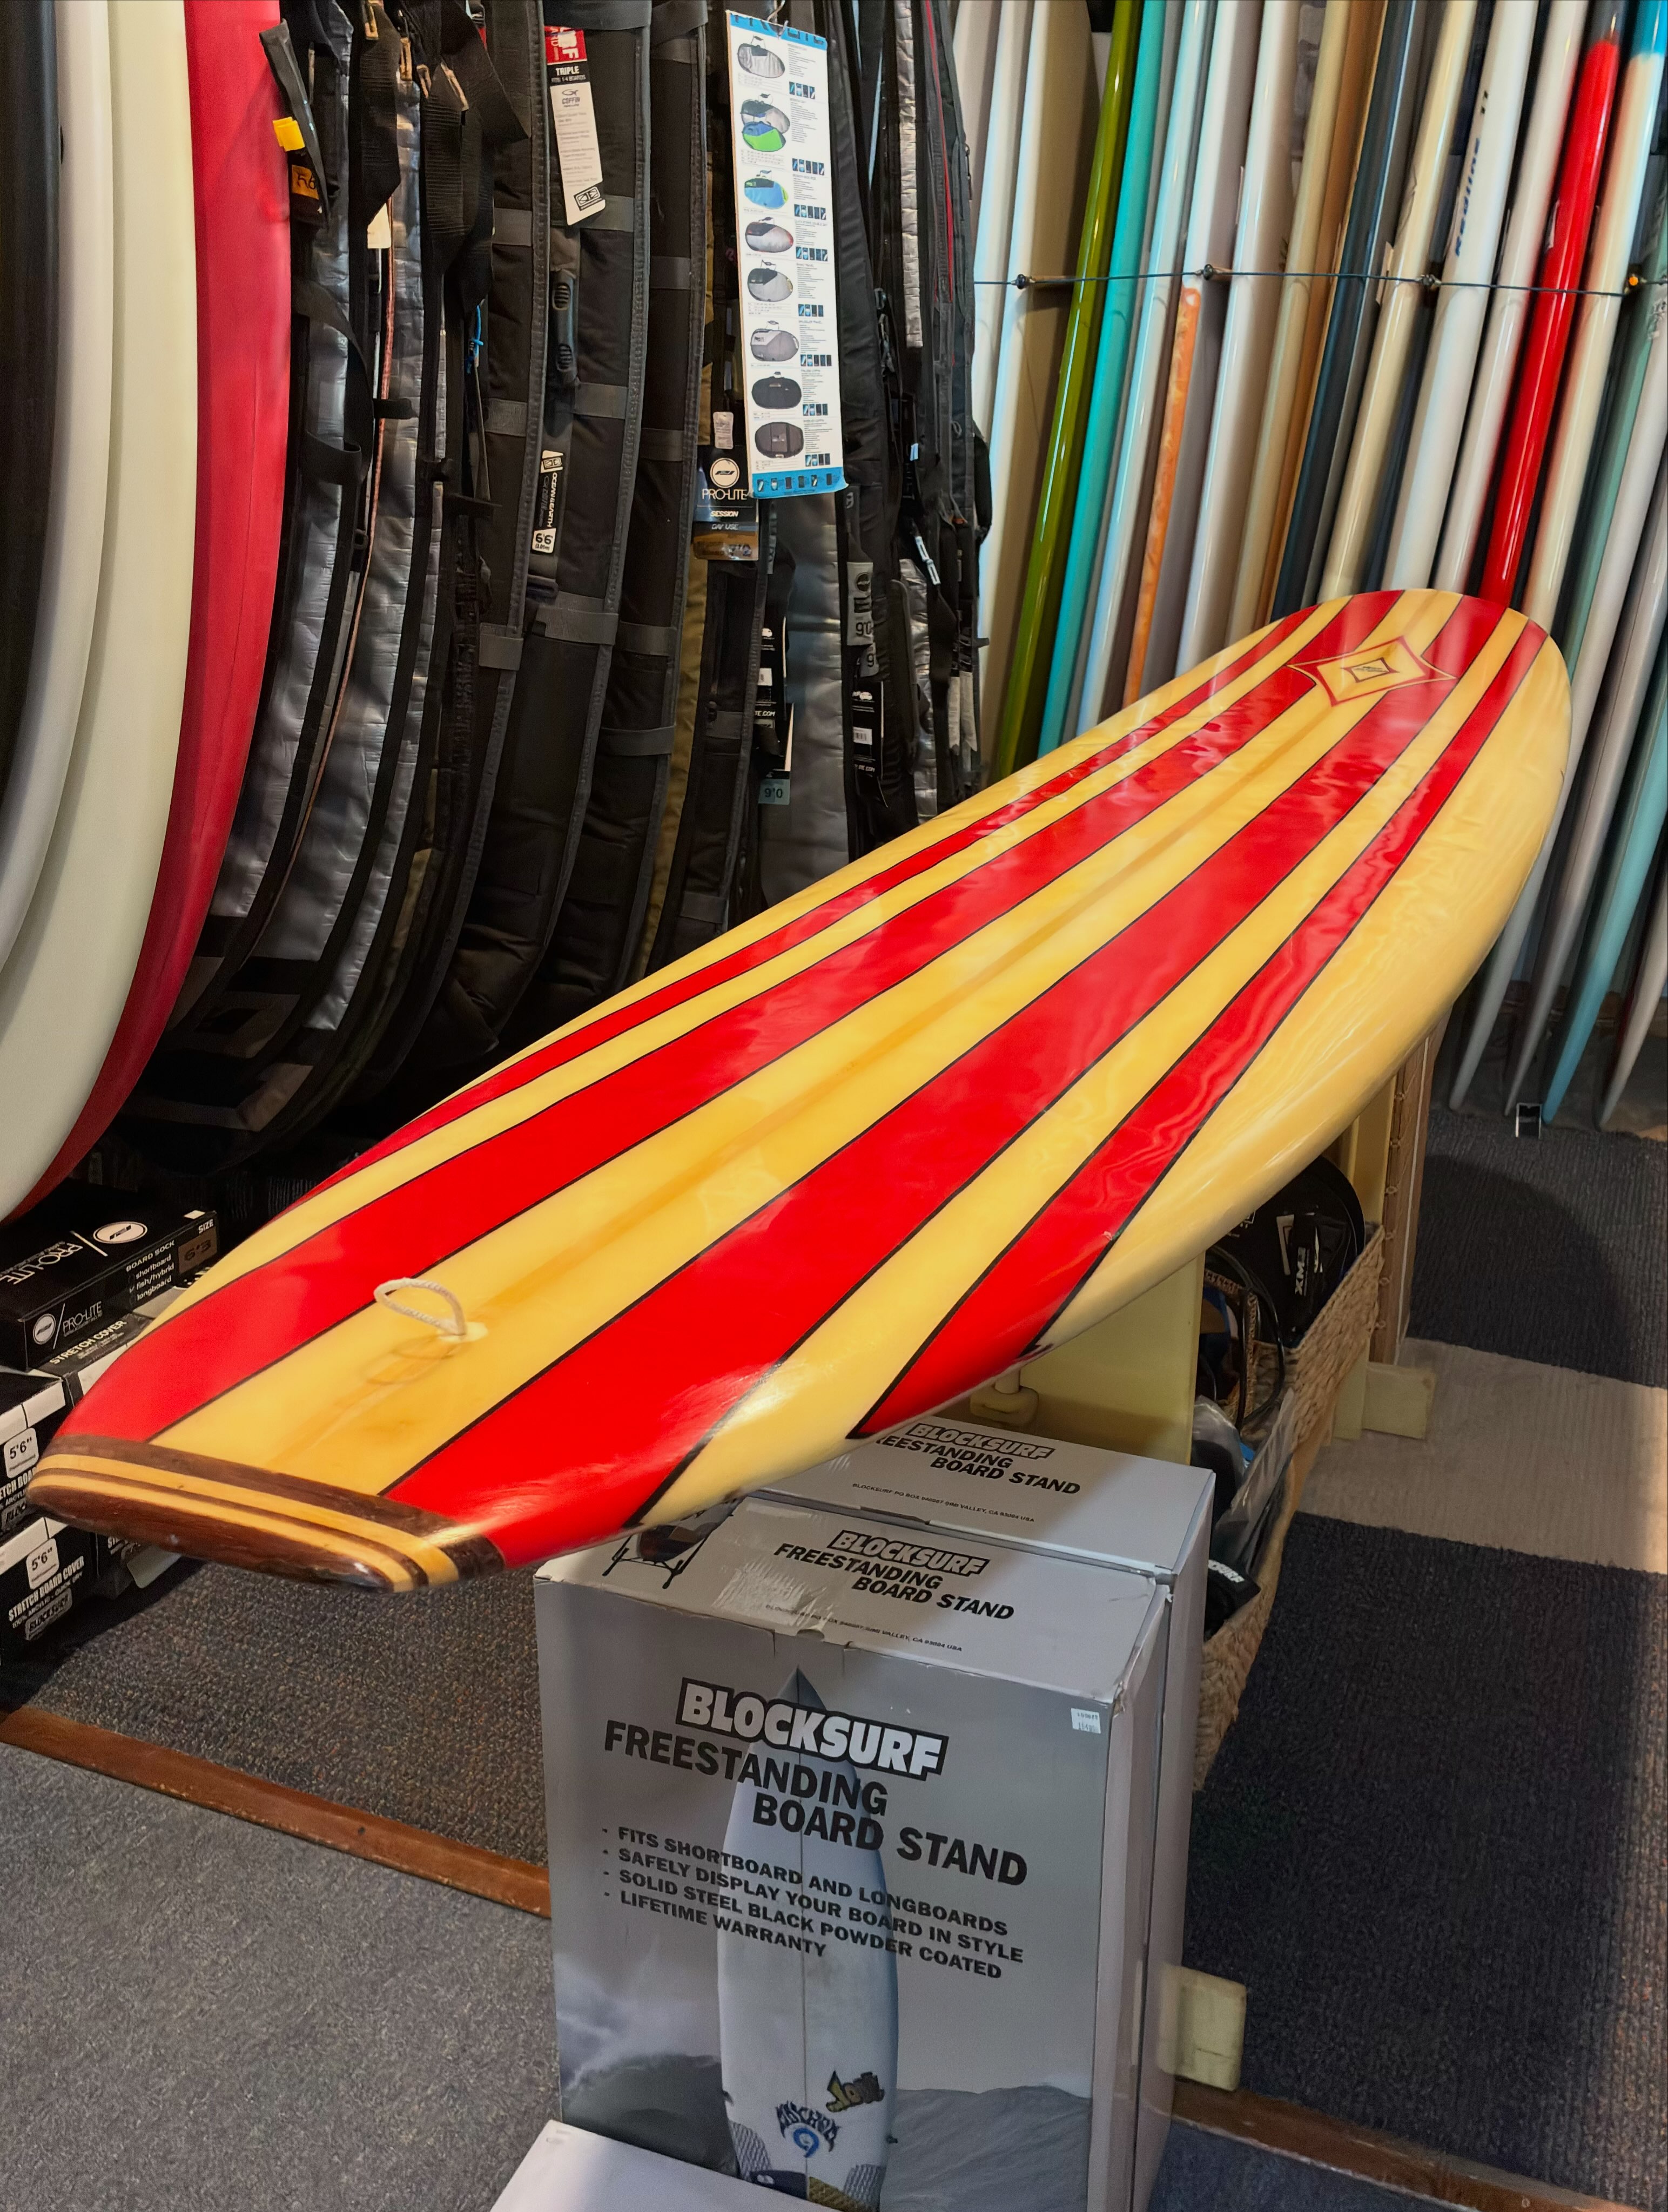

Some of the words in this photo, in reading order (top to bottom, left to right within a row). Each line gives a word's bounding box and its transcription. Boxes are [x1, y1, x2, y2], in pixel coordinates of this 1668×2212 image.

[555, 65, 580, 76] TRIPLE
[702, 489, 748, 501] PRO-LITE
[198, 1219, 214, 1235] SIZE
[126, 1253, 153, 1272] BOARD
[154, 1240, 174, 1256] SOCK
[136, 1253, 171, 1279] shortboard
[136, 1262, 174, 1290] fish/hybrid
[137, 1275, 172, 1301] longboard
[63, 1300, 102, 1335] PRO-LITE
[50, 1338, 96, 1365] STRETCH
[93, 1320, 127, 1340] COVER
[10, 1437, 32, 1459] 5'6"
[877, 1434, 1014, 1469] EESTANDING
[911, 1425, 1051, 1458] BLOCKSURF
[0, 1479, 17, 1500] ETCH
[17, 1467, 37, 1489] BOA
[930, 1457, 1005, 1480] BOARD
[1008, 1472, 1080, 1495] STAND
[960, 1503, 987, 1514] VALLEY,
[31, 1546, 53, 1572] 5'6"
[774, 1543, 944, 1590] FREESTANDING
[831, 1532, 987, 1576] BLOCKSURF
[8, 1589, 39, 1622] STRETCH
[39, 1572, 63, 1599] BOARD
[63, 1555, 85, 1580] COVER
[851, 1576, 933, 1603] BOARD
[936, 1593, 1014, 1620] STAND
[947, 1644, 962, 1652] USA
[681, 1682, 942, 1777] BLOCKSURF
[604, 1720, 888, 1817] FREESTANDING
[753, 1792, 884, 1851] BOARD
[897, 1827, 1027, 1885] STAND
[618, 1826, 659, 1848] FITS
[664, 1837, 802, 1885] SHORTBOARD
[809, 1876, 852, 1897] AND
[859, 1887, 1008, 1936] LONGBOARDS
[619, 1848, 691, 1878] SAFELY
[696, 1867, 779, 1901] DISPLAY
[785, 1890, 842, 1918] YOUR
[849, 1907, 923, 1937] BOARD
[929, 1926, 951, 1945] IN
[958, 1933, 1024, 1964] STYLE
[620, 1870, 678, 1896] SOLID
[683, 1886, 743, 1914] STEEL
[748, 1902, 815, 1933] BLACK
[820, 1921, 912, 1958] POWDER
[919, 1946, 1002, 1979] COATED
[621, 1890, 708, 1925] LIFETIME
[713, 1914, 826, 1958] WARRANTY
